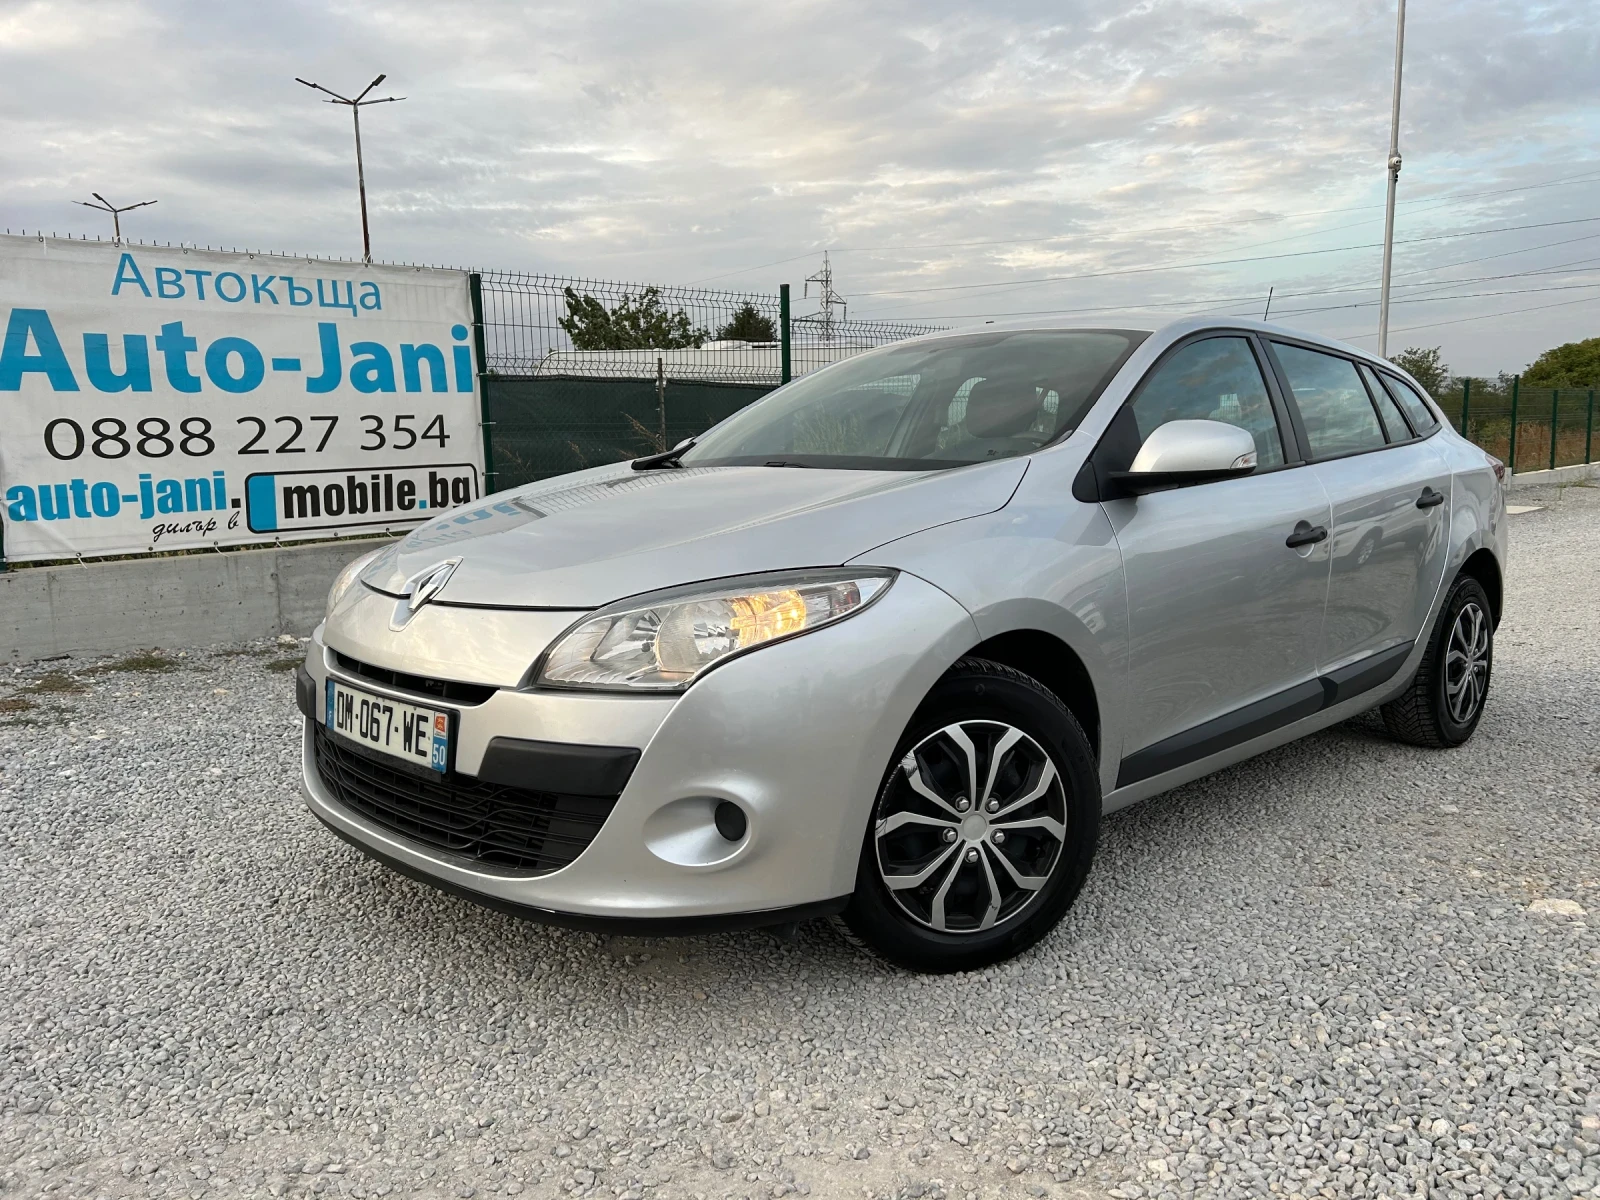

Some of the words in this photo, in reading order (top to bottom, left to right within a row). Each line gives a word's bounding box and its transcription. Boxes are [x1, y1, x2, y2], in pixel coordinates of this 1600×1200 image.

[111, 252, 382, 317] Автокъща
[0, 308, 474, 393] Auto-Jani
[43, 416, 216, 460] 0888
[236, 416, 339, 456] 227
[359, 414, 451, 451] 354
[152, 517, 218, 543] дилър
[432, 743, 446, 766] 50
